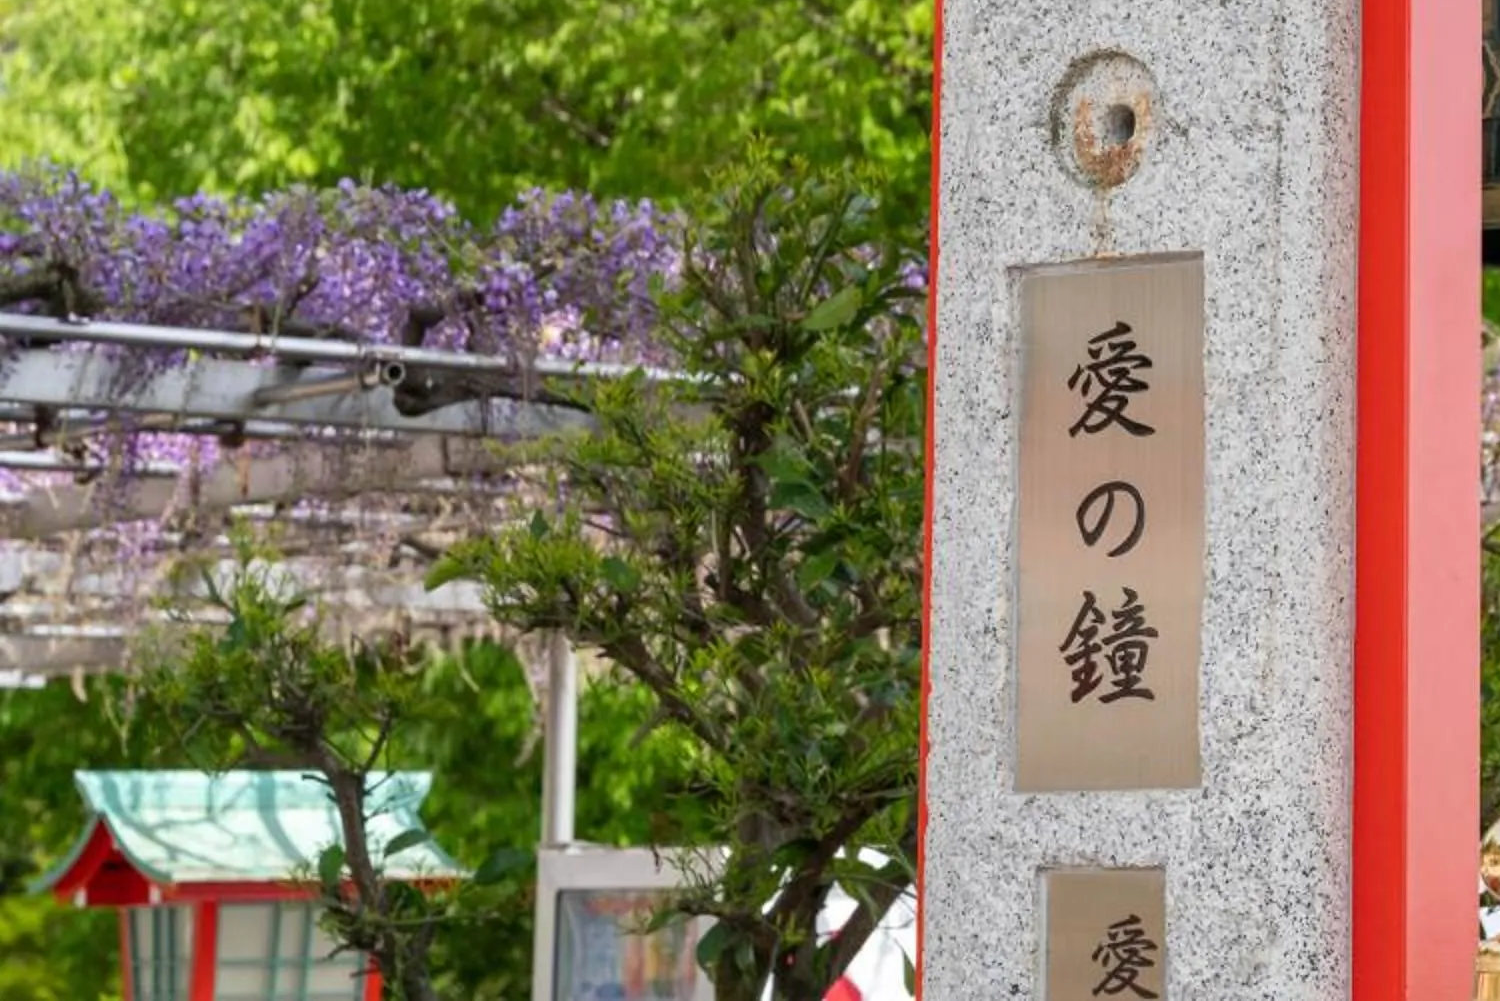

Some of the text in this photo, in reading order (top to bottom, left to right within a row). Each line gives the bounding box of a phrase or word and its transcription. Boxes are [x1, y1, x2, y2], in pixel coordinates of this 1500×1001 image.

[1059, 320, 1159, 704] 愛の鐘
[1091, 913, 1160, 1000] 愛
